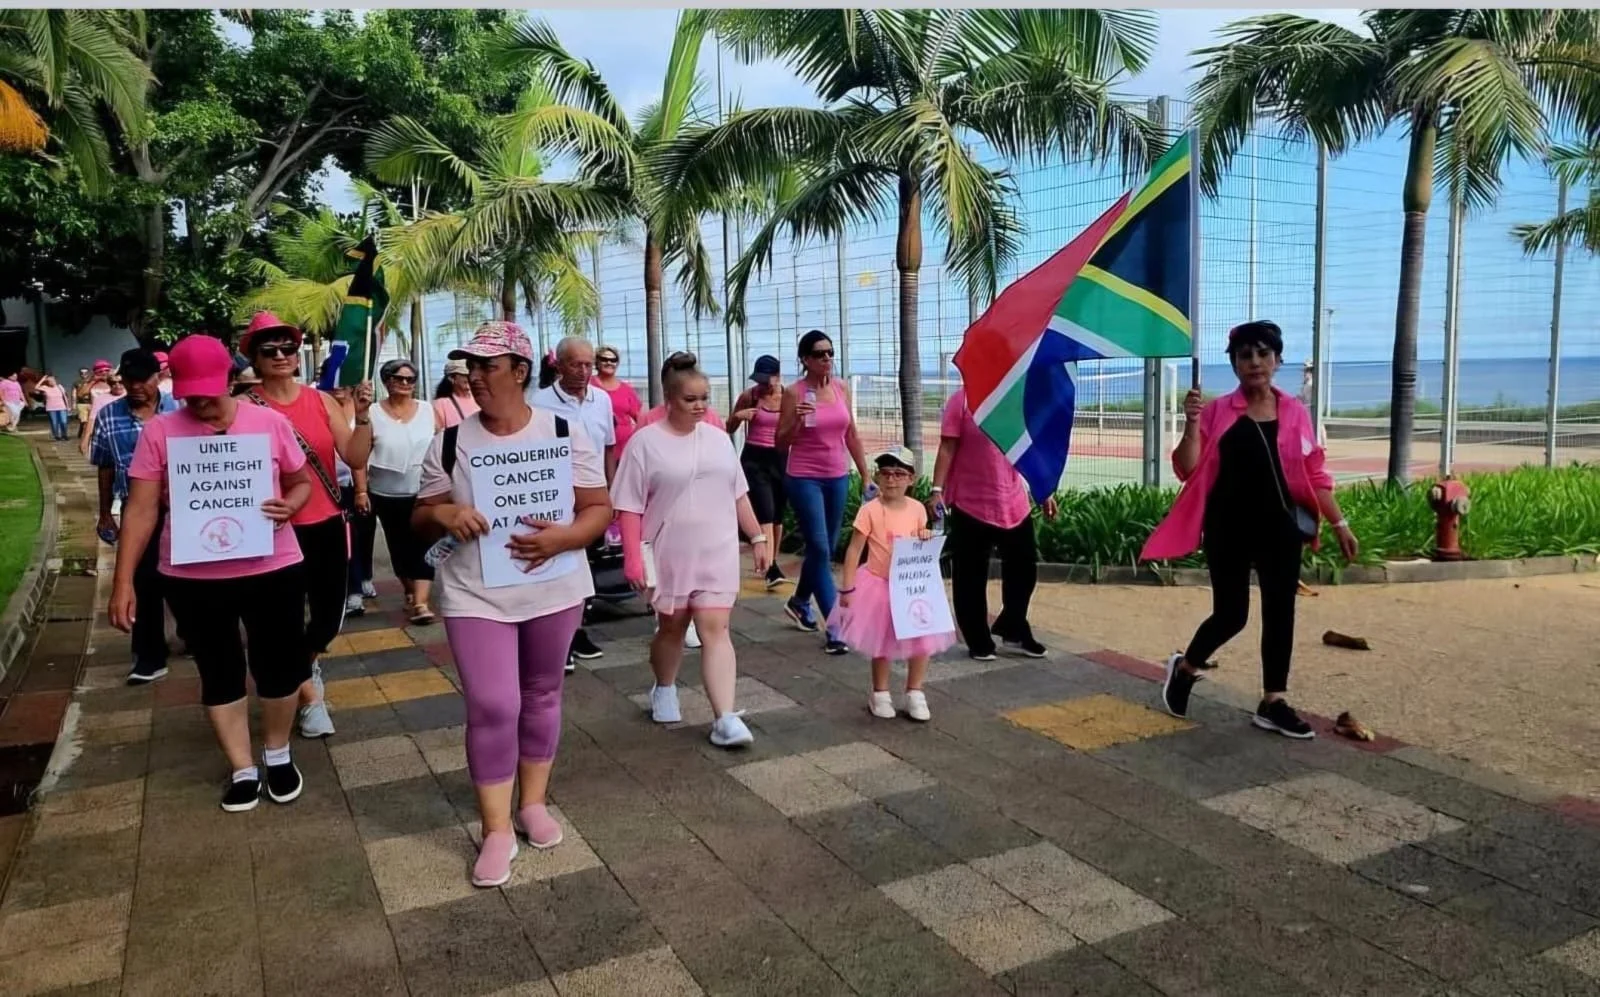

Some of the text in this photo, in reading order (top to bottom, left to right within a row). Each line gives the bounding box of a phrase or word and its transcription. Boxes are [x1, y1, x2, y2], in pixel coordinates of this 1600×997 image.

[199, 442, 238, 454] UNITE
[470, 446, 569, 468] CONQUERING
[177, 460, 263, 475] IN THE FIGHT
[493, 468, 556, 486] CANCER
[190, 479, 252, 493] AGAINST
[189, 496, 254, 511] CANCER!
[494, 489, 559, 508] ONE STEP
[491, 516, 509, 530] AT
[513, 515, 525, 527] A
